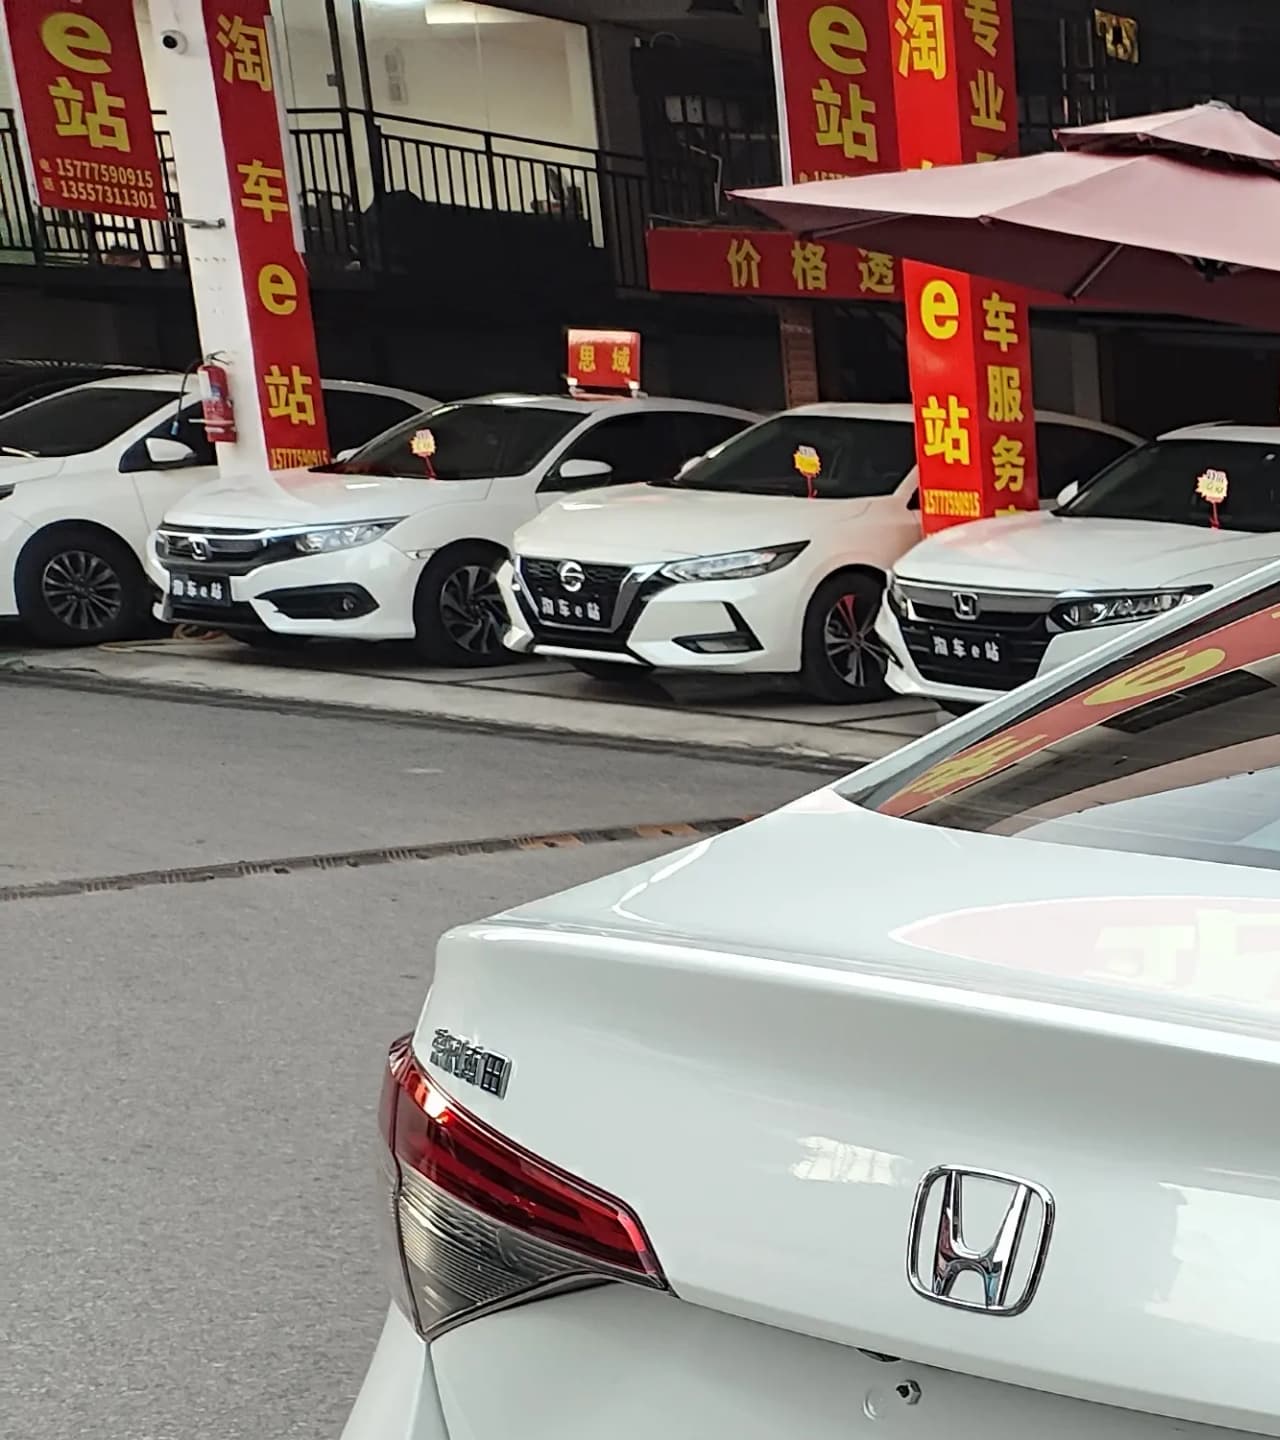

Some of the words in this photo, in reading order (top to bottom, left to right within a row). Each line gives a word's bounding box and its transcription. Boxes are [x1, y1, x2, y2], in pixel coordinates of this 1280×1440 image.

[56, 157, 154, 190] 15777590915
[60, 180, 158, 210] 13557311301
[215, 15, 318, 426] 淘车e站
